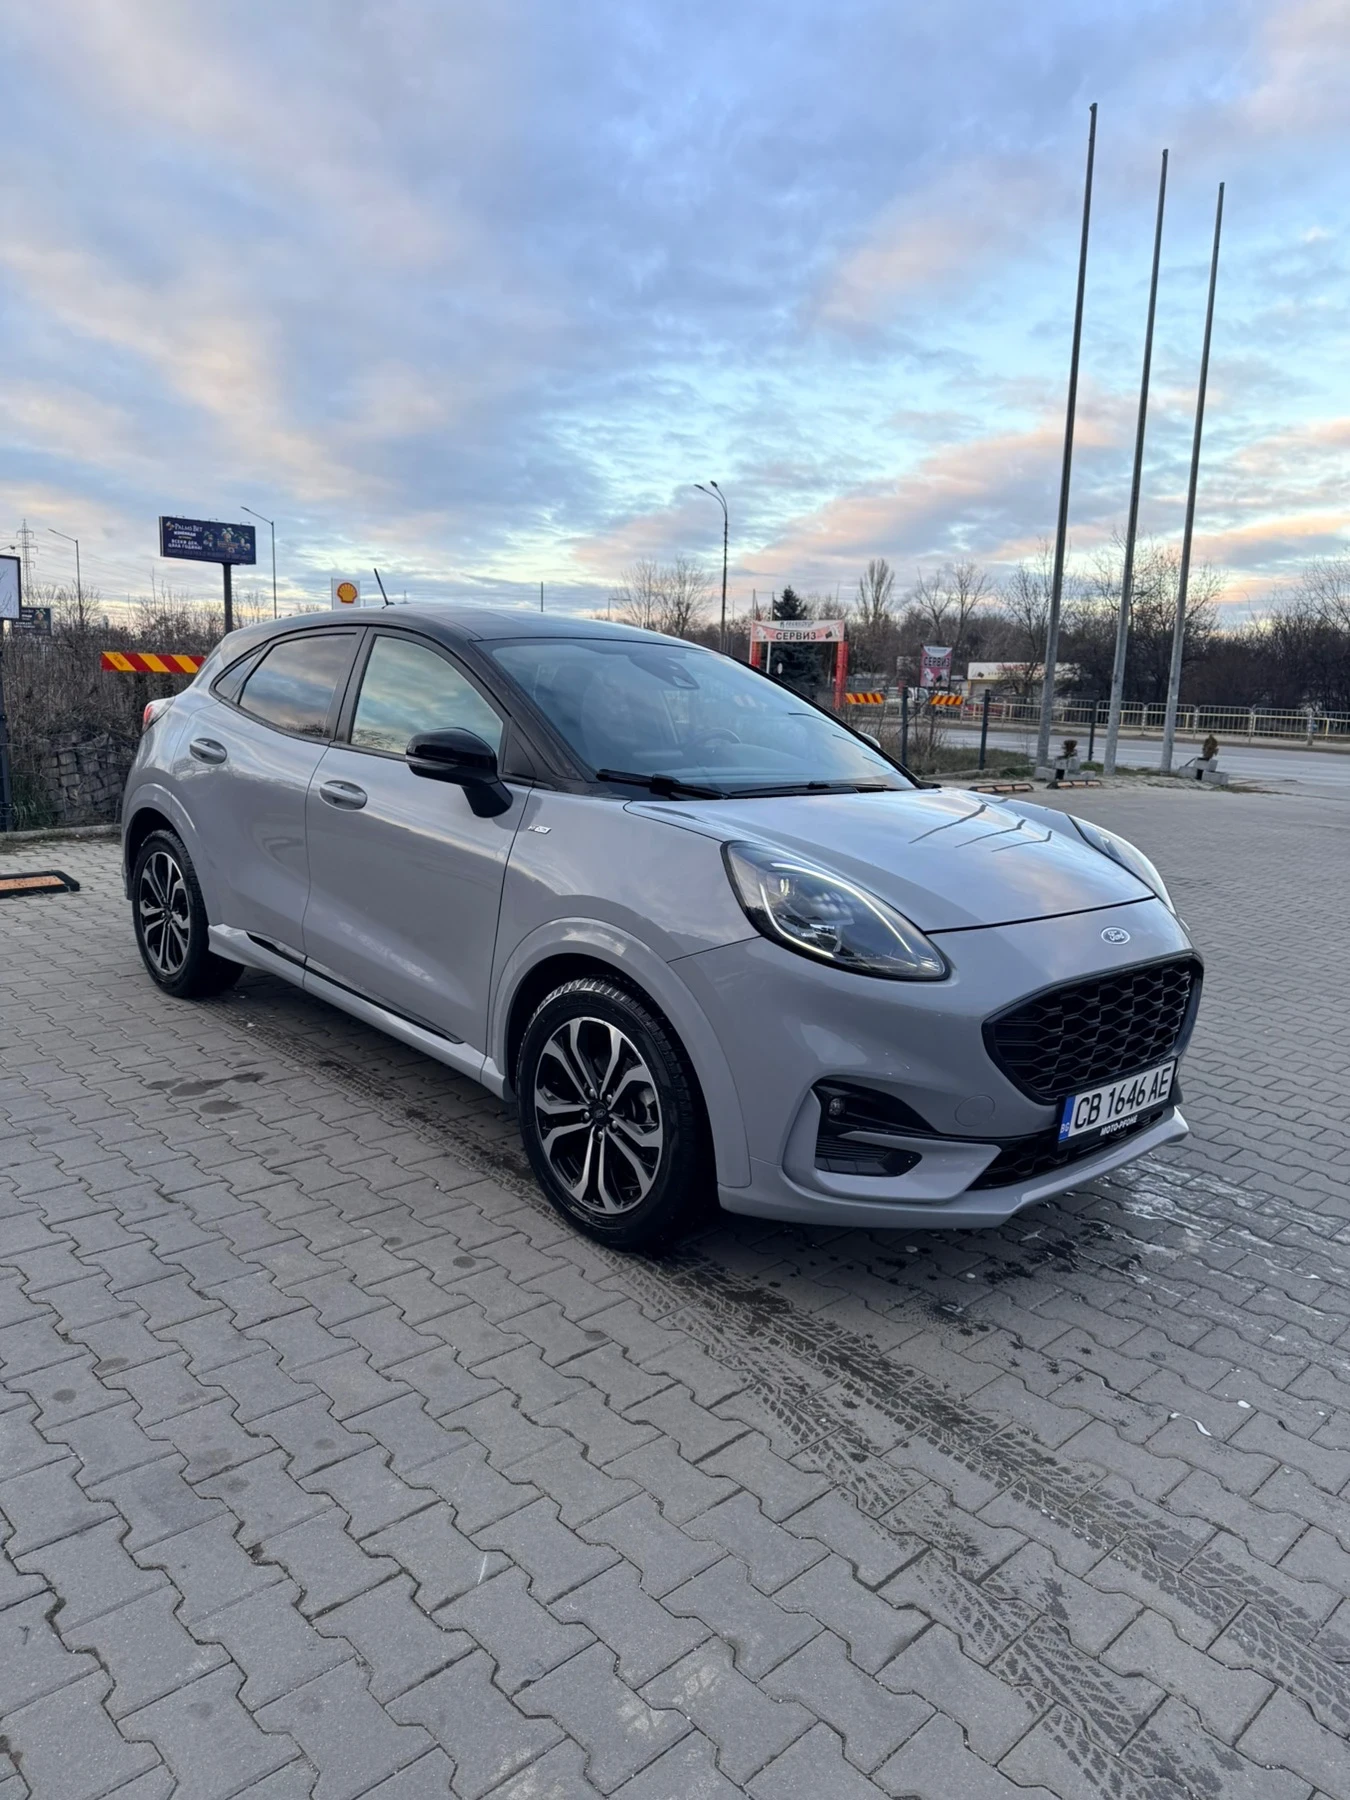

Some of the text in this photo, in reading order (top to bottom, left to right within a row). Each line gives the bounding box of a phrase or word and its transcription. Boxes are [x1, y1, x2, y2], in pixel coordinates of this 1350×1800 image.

[775, 631, 817, 641] СЕРВИЗ
[923, 656, 950, 667] СЕРВИЗ
[1074, 1066, 1172, 1130] CB 1646 AE
[1060, 1122, 1070, 1134] BG
